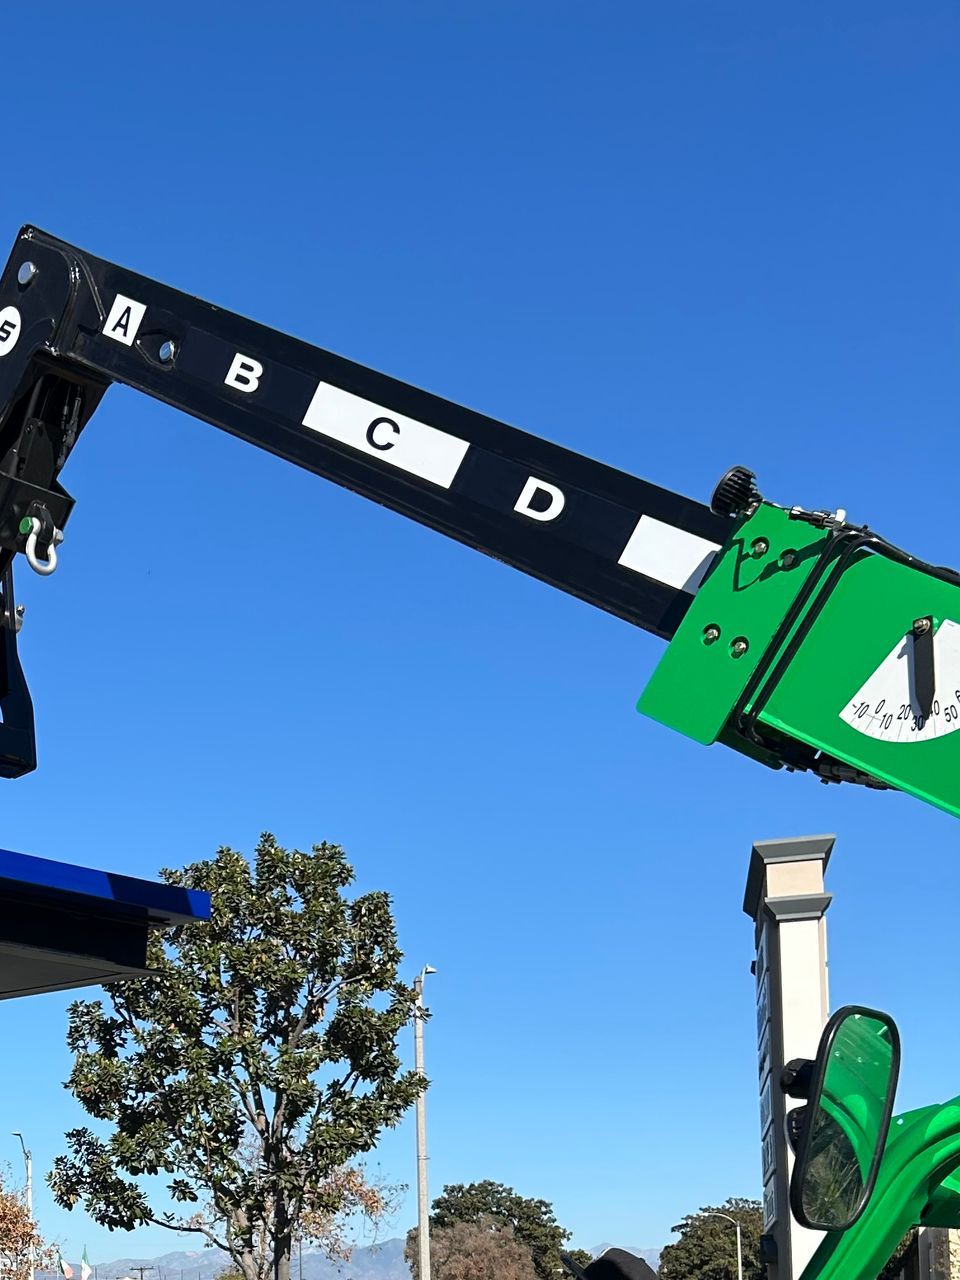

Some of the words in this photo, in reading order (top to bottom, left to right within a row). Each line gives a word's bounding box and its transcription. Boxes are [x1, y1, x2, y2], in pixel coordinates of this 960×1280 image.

[111, 305, 132, 338] A
[224, 352, 264, 393] B
[366, 416, 401, 451] C
[513, 475, 566, 522] D
[852, 701, 870, 719] -10
[879, 713, 893, 729] 10
[897, 704, 911, 720] 20
[911, 715, 924, 731] 30
[943, 704, 959, 723] 50
